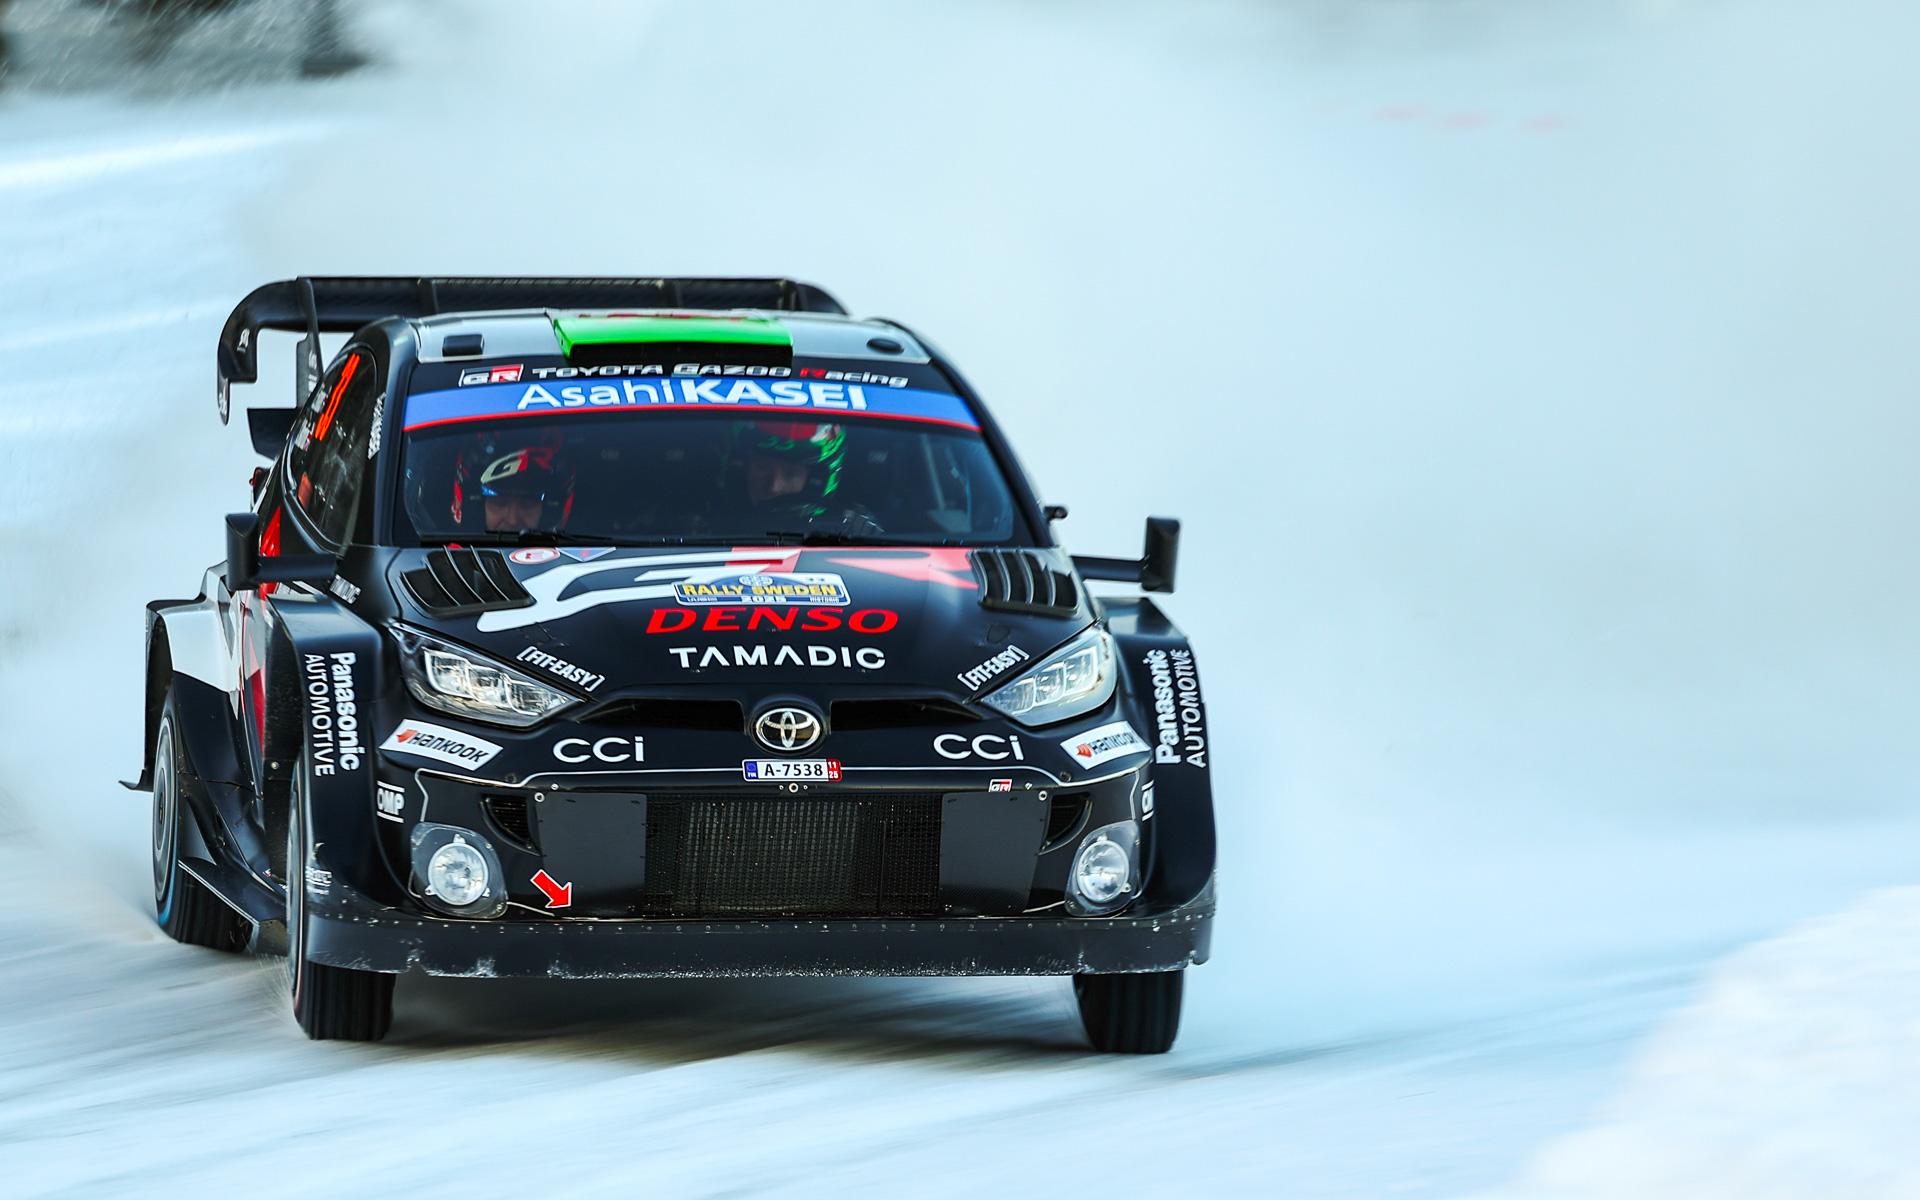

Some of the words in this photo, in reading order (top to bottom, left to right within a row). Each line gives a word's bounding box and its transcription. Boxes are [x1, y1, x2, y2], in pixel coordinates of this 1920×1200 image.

[461, 368, 520, 387] GR
[532, 365, 664, 379] TOYOTA
[673, 363, 792, 378] GAZOO
[681, 584, 744, 596] RALLY
[751, 584, 838, 596] SWEDEN
[646, 607, 899, 634] DENSO
[668, 645, 886, 670] TAMADIC
[304, 653, 336, 777] AUTOMOTIVE
[329, 651, 366, 771] Panasonic
[1142, 649, 1182, 764] Panasonic
[1170, 648, 1207, 768] AUTOMOTIVE
[764, 763, 824, 777] A-7538
[377, 787, 405, 816] OMP
